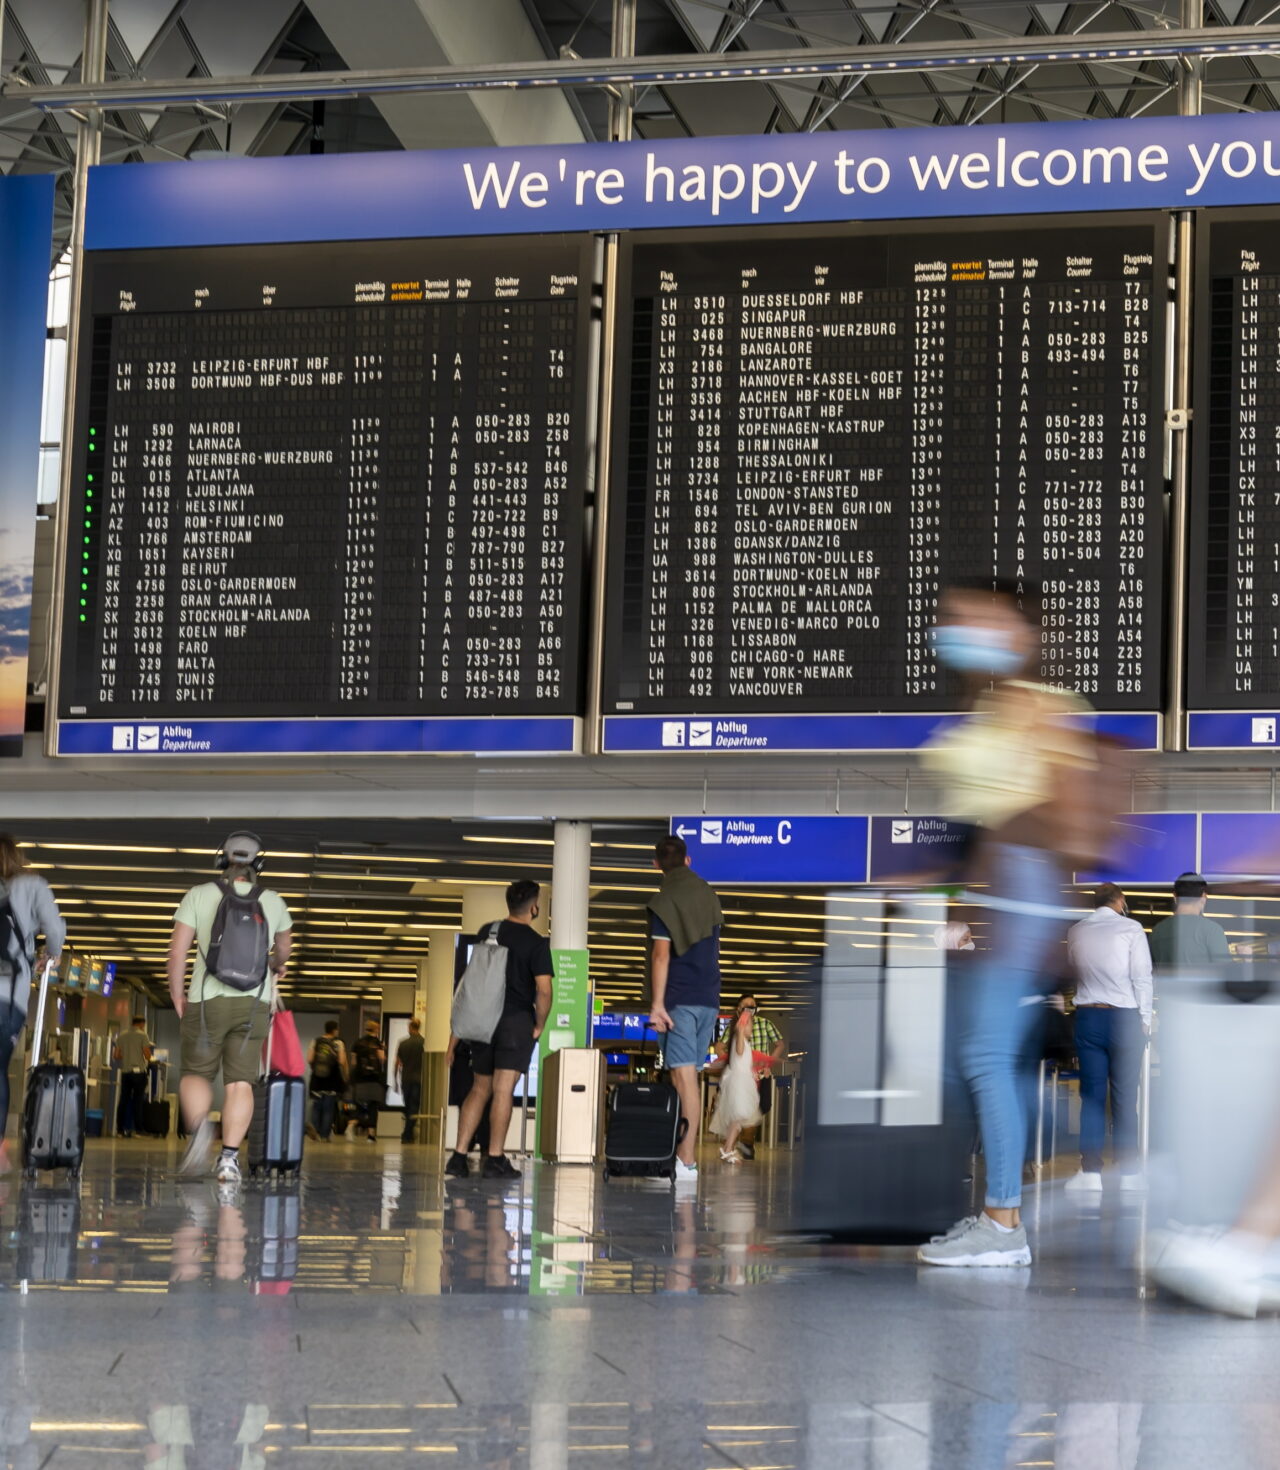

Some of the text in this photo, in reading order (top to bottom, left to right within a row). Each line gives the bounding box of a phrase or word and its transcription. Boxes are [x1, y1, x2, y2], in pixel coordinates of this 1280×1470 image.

[463, 159, 625, 210] We're
[644, 152, 817, 216] happy
[834, 149, 891, 195] to
[908, 137, 1169, 191] welcome
[1241, 250, 1255, 261] Flug
[1241, 261, 1260, 272] Flight
[742, 291, 863, 308] DUESSELDORF HBF
[742, 309, 805, 324] SINGAPUR
[741, 322, 896, 339] NUERNBERG-WUERZBURG
[741, 341, 812, 356] BANGALORE
[193, 357, 329, 373] LEIPZIG-ERFURT HBF
[741, 357, 811, 372] LANZAROTE
[192, 372, 343, 389] DORTMUND HBF-DUS HBF
[740, 370, 903, 387] HANNOVER-KASSEL-GOET
[739, 387, 902, 404] AACHEN HBF-KOELN HBF
[739, 405, 843, 420] STUTTGART HBF
[189, 422, 240, 435] NAIROBI
[738, 420, 884, 436] KOPENHAGEN-KASTRUP
[189, 437, 241, 450] LARNACA
[738, 437, 818, 452] BIRMINGHAM
[188, 450, 333, 466] NUERNBERG-WUERZBURG
[738, 453, 832, 468] THESSALONIKI
[187, 468, 239, 481] ATLANTA
[737, 468, 883, 484] LEIPZIG-ERFURT HBF
[187, 484, 254, 497] LJUBLJANA
[737, 485, 858, 500] LONDON-STANSTED
[186, 499, 244, 513] HELSINKI
[736, 501, 891, 516] TEL AVIV-BEN GURION
[185, 514, 283, 528] ROM-FIUMICINO
[735, 518, 857, 533] OSLO-GARDERMOEN
[184, 531, 252, 544] AMSTERDAM
[734, 535, 840, 549] GDANSK/DANZIG
[183, 547, 234, 560] KAYSERI
[734, 550, 873, 565] WASHINGTON-DULLES
[182, 562, 227, 575] BEIRUT
[733, 567, 880, 581] DORTMUND-KOELN HBF
[181, 577, 296, 591] OSLO-GARDERMOEN
[733, 583, 872, 598] STOCKHOLM-ARLANDA
[181, 593, 272, 607] GRAN CANARIA
[733, 600, 872, 614] PALMA DE MALLORCA
[180, 609, 310, 623] STOCKHOLM-ARLANDA
[732, 616, 879, 630] VENEDIG-MARCO POLO
[179, 625, 246, 638] KOELN HBF
[732, 633, 796, 646] LISSABON
[179, 641, 208, 654] FARO
[178, 657, 215, 669] MALTA
[731, 649, 844, 663] CHICAGO-O HARE
[177, 673, 214, 685] TUNIS
[730, 666, 853, 679] NEW YORK-NEWARK
[176, 688, 213, 701] SPLIT
[730, 682, 802, 695] VANCOUVER
[163, 725, 192, 740] Abflug
[716, 721, 748, 735] Abflug
[162, 739, 210, 752] Departures
[715, 734, 768, 748] Departures
[726, 820, 792, 845] Abflug C
[917, 820, 947, 832] Abflug
[726, 833, 773, 846] Departures
